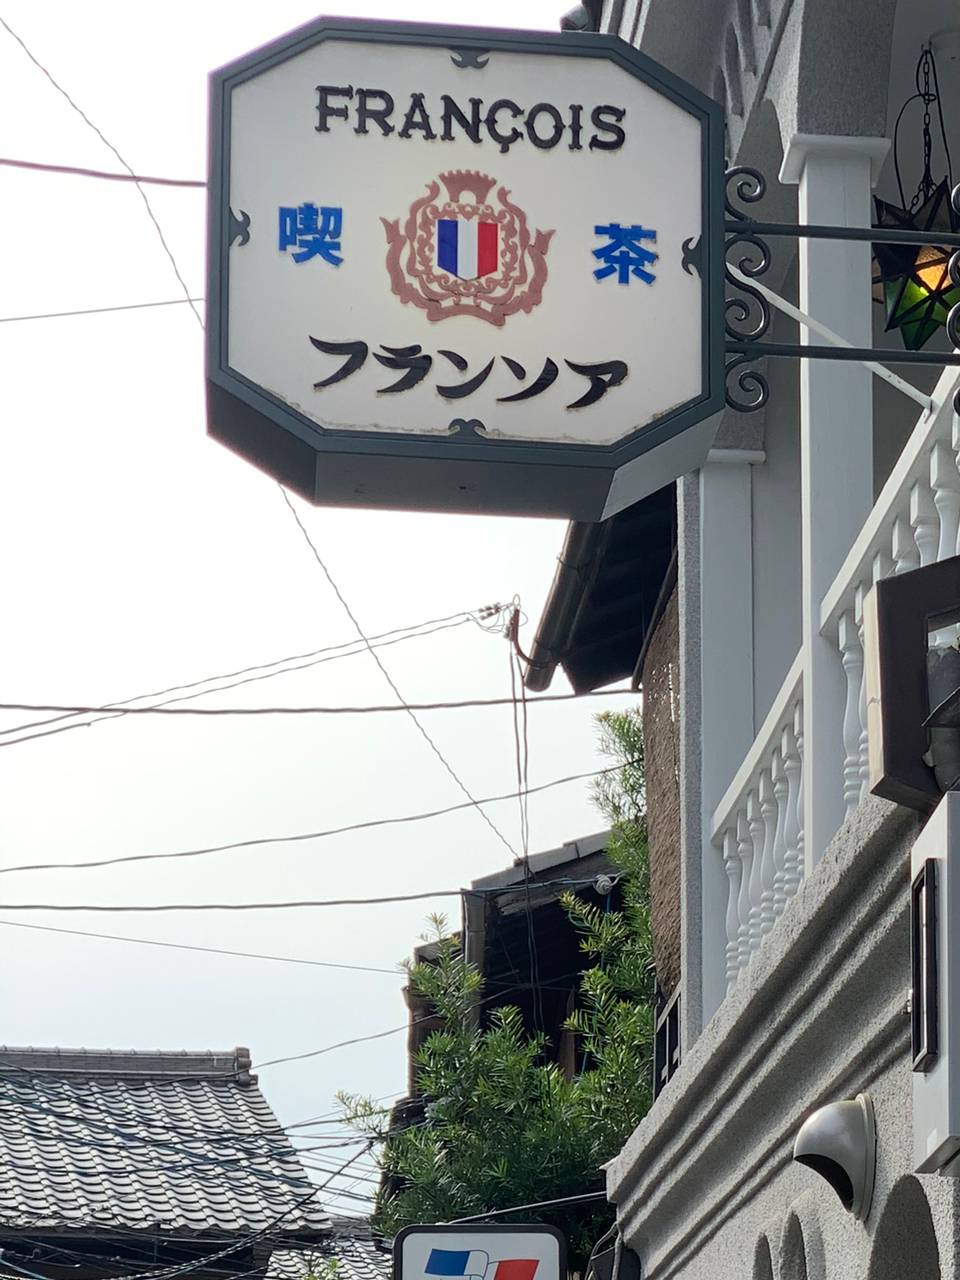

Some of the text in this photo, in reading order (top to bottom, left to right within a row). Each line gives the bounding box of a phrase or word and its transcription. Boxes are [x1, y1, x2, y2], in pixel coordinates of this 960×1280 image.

[314, 84, 626, 153] FRANÇOIS
[308, 335, 628, 410] フランソア
